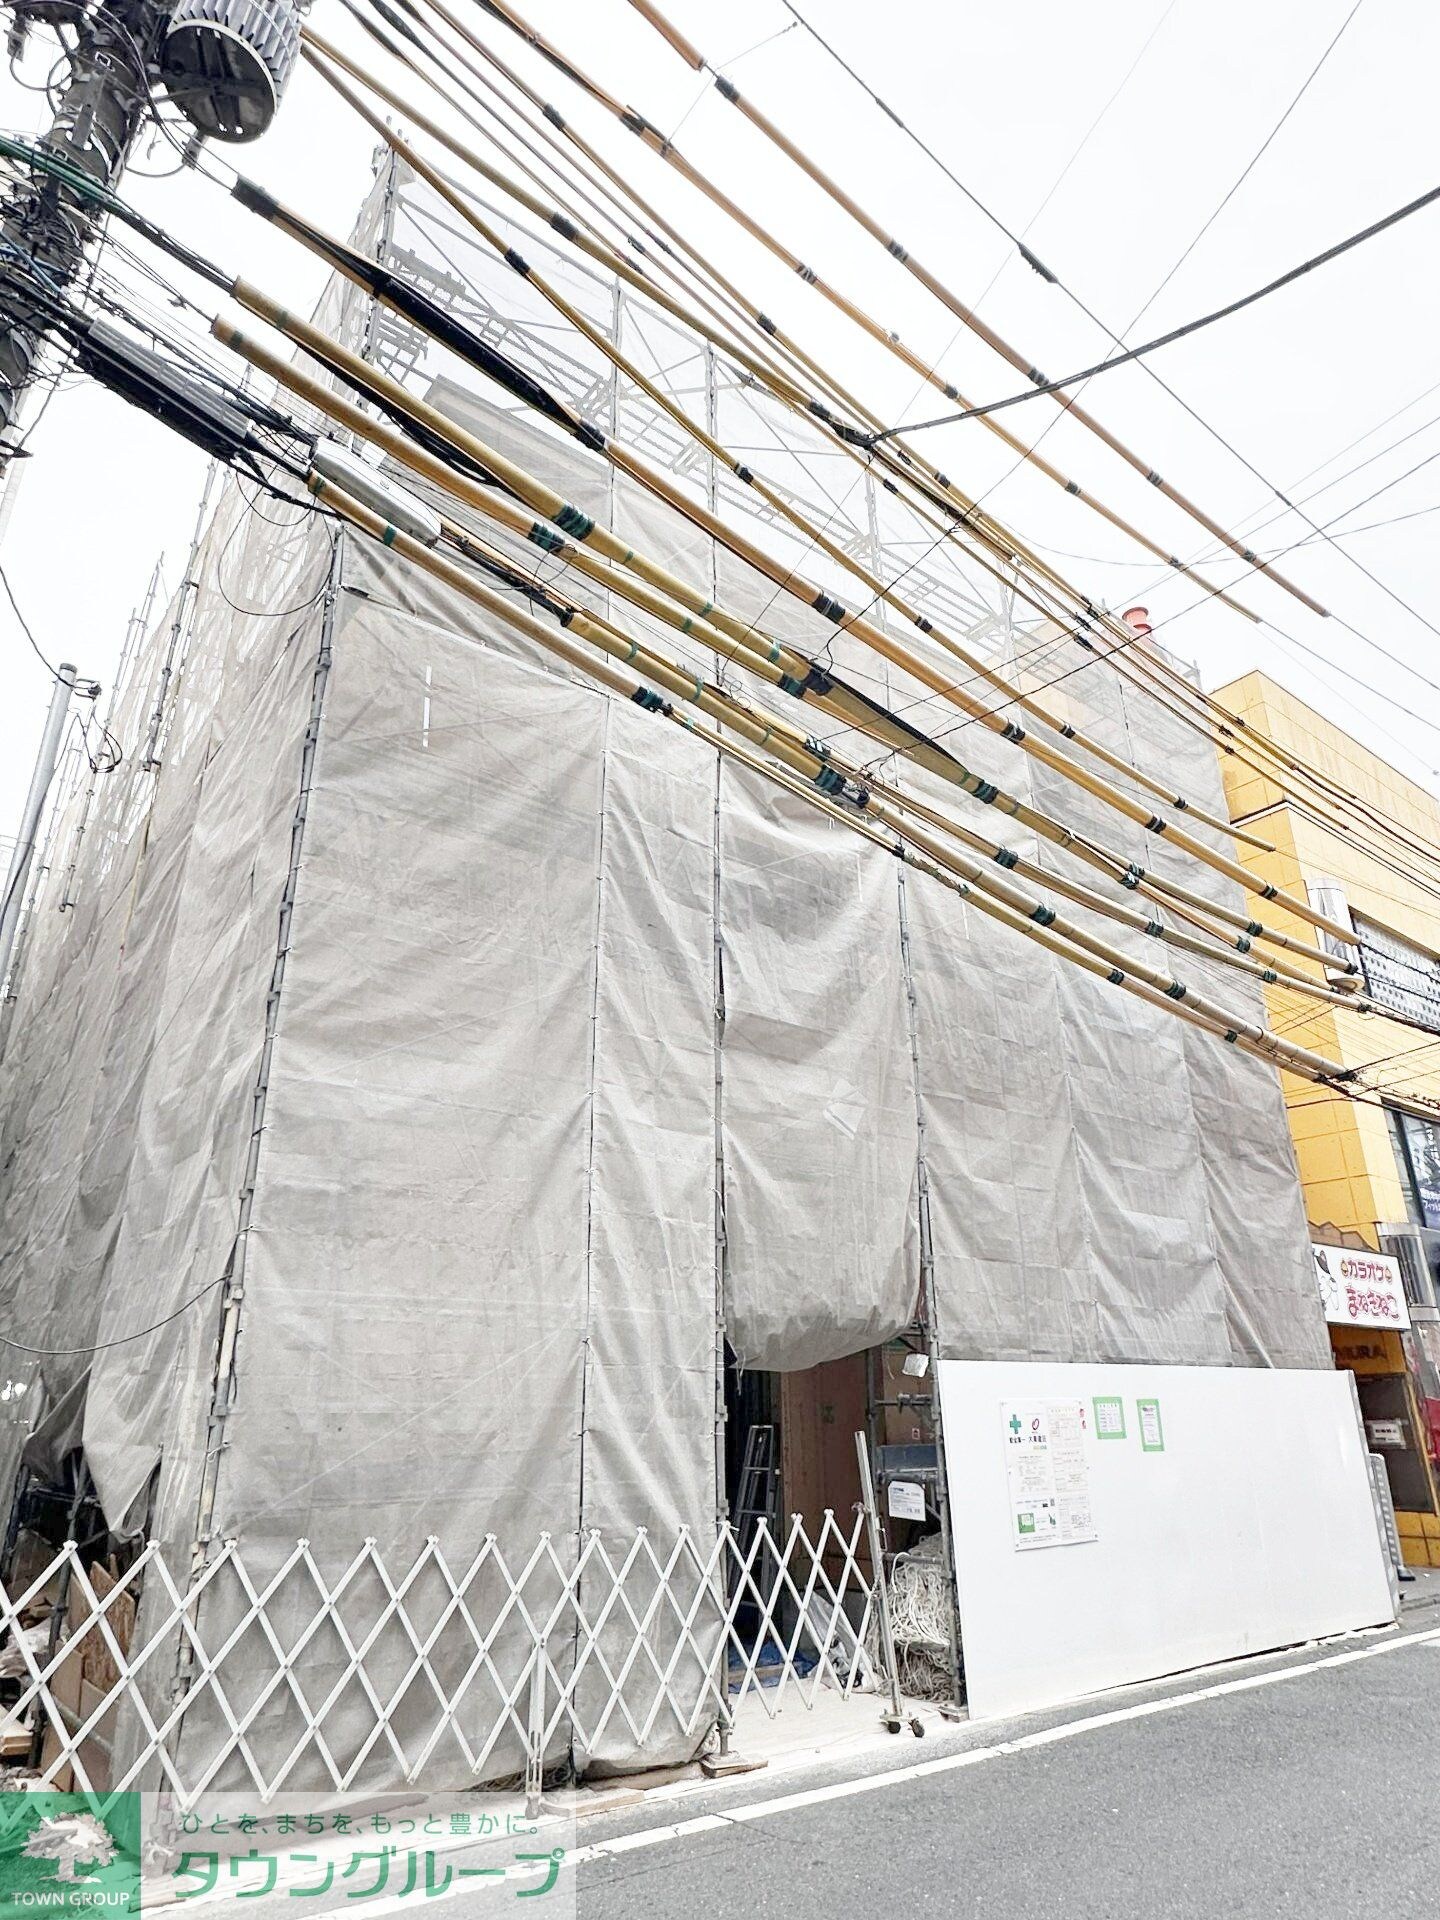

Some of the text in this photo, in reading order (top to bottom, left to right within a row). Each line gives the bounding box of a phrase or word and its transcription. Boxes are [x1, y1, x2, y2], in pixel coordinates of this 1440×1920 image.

[1347, 1259, 1384, 1282] カラオケ
[1345, 1286, 1400, 1318] まねきねこ
